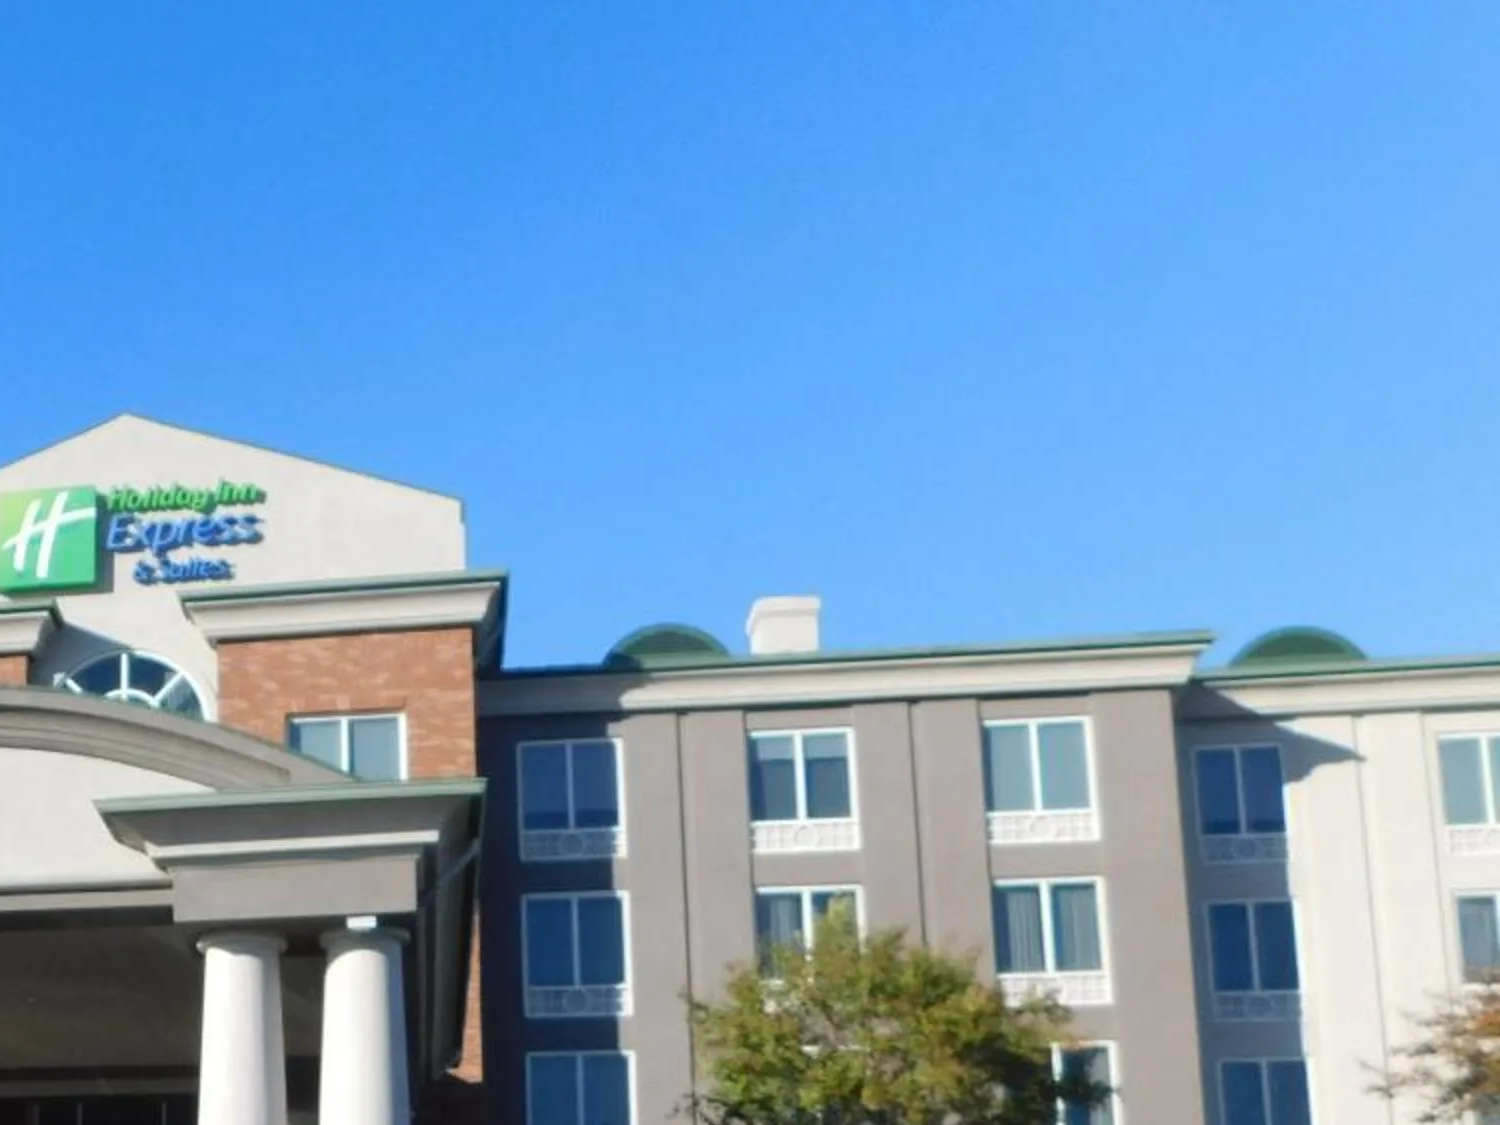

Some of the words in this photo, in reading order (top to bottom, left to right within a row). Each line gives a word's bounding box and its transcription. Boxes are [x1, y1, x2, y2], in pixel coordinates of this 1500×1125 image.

[108, 483, 214, 514] Holiday
[214, 478, 263, 504] Inn
[106, 513, 263, 556] Express
[134, 560, 157, 583] &
[159, 556, 234, 581] Suites
